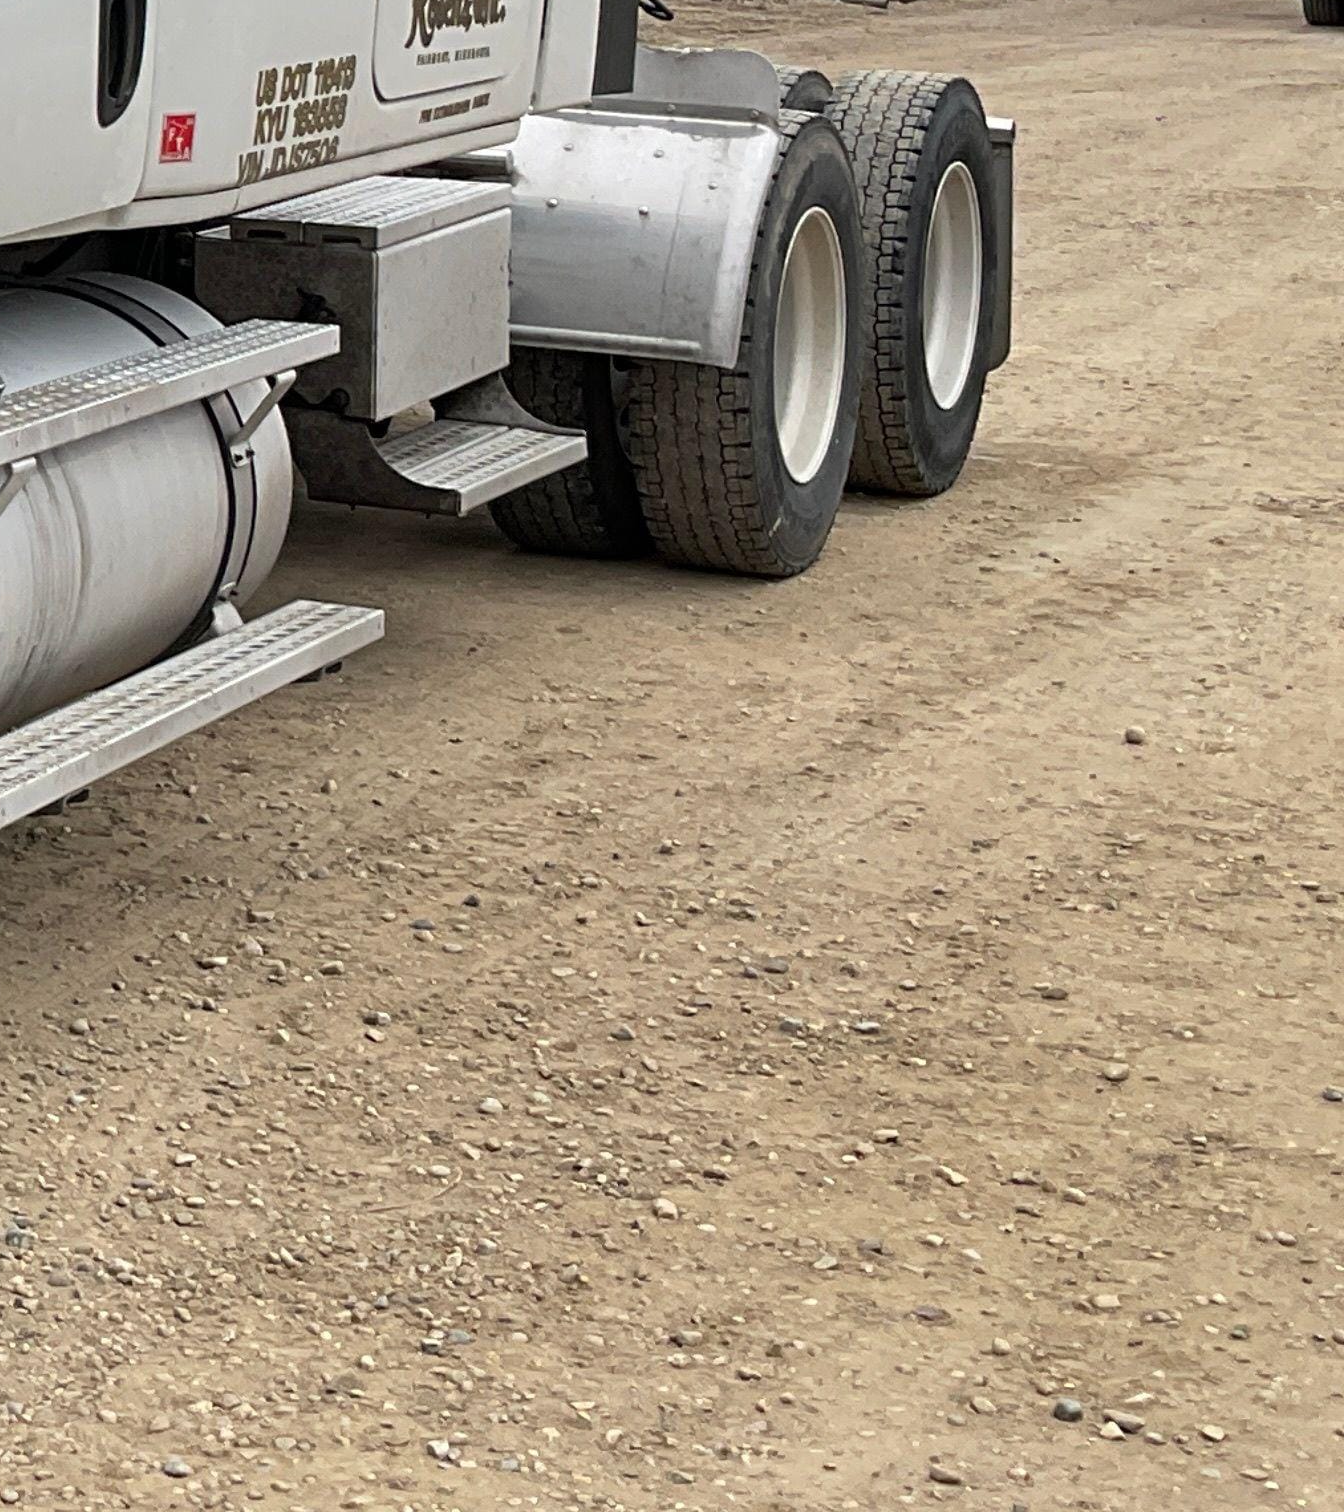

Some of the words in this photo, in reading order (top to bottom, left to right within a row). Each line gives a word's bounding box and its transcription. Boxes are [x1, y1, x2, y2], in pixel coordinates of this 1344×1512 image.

[256, 67, 278, 107] US
[280, 62, 313, 102] DOT
[253, 104, 290, 146] KYU
